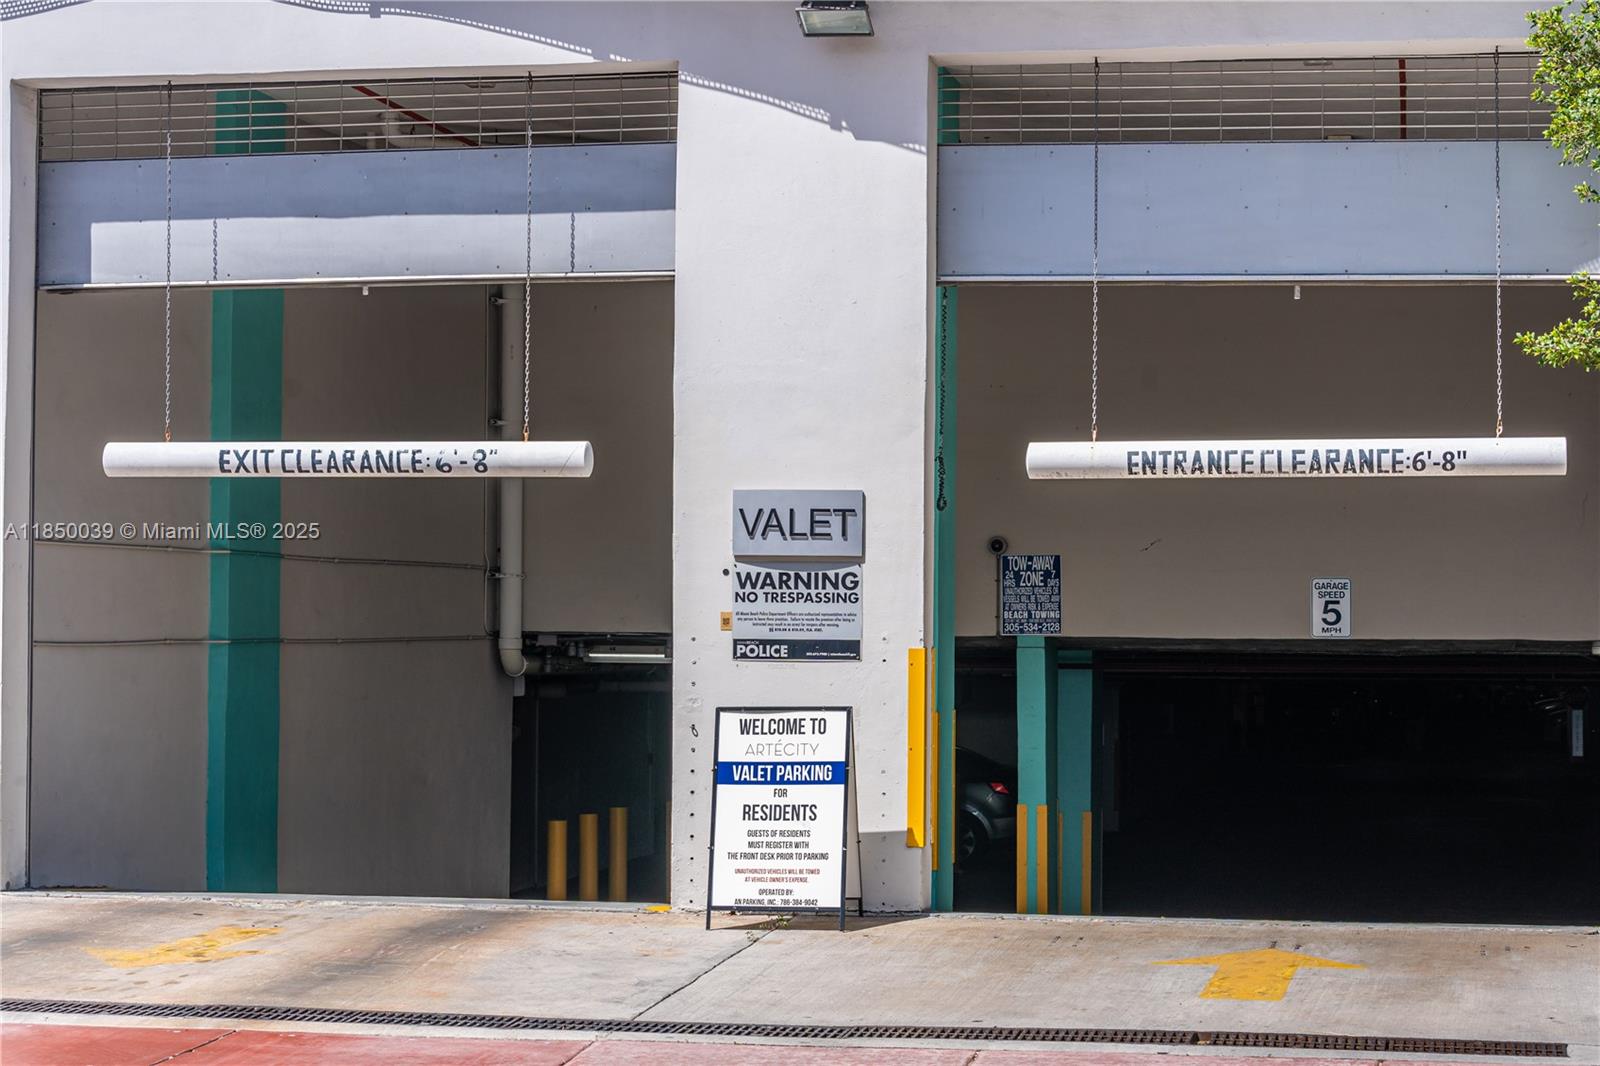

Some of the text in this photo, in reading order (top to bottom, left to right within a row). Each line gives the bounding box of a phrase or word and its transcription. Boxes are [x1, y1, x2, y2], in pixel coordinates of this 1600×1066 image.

[218, 449, 274, 473] EXIT
[1127, 450, 1255, 475] ENTRANCE
[738, 508, 857, 540] VALET
[1007, 556, 1055, 571] TOW-AWAY
[1005, 571, 1014, 579] 24
[1020, 571, 1044, 586] ZONE
[1051, 570, 1056, 578] 7
[736, 572, 859, 590] WARNING
[1004, 579, 1016, 587] HRS
[1314, 582, 1349, 590] GARAGE
[735, 592, 859, 604] NO TRESPASSING
[1004, 611, 1060, 619] BEACH TOWING
[1321, 600, 1342, 626] 5
[1004, 622, 1060, 631] 305-534-2128
[736, 645, 788, 657] POLICE
[739, 718, 827, 735] WELCOME TO
[745, 739, 819, 756] ARTÉCITY
[732, 764, 833, 781] VALET PARKING
[773, 788, 788, 798] FOR
[742, 804, 817, 821] RESIDENTS
[747, 830, 770, 838] GUESTS
[779, 830, 811, 838] RESIDENTS
[748, 841, 809, 849] MUST REGISTER WITH
[727, 852, 829, 860] THE FRONT DESK PRIOR TO PARKING
[780, 898, 818, 906] 786-384-9042
